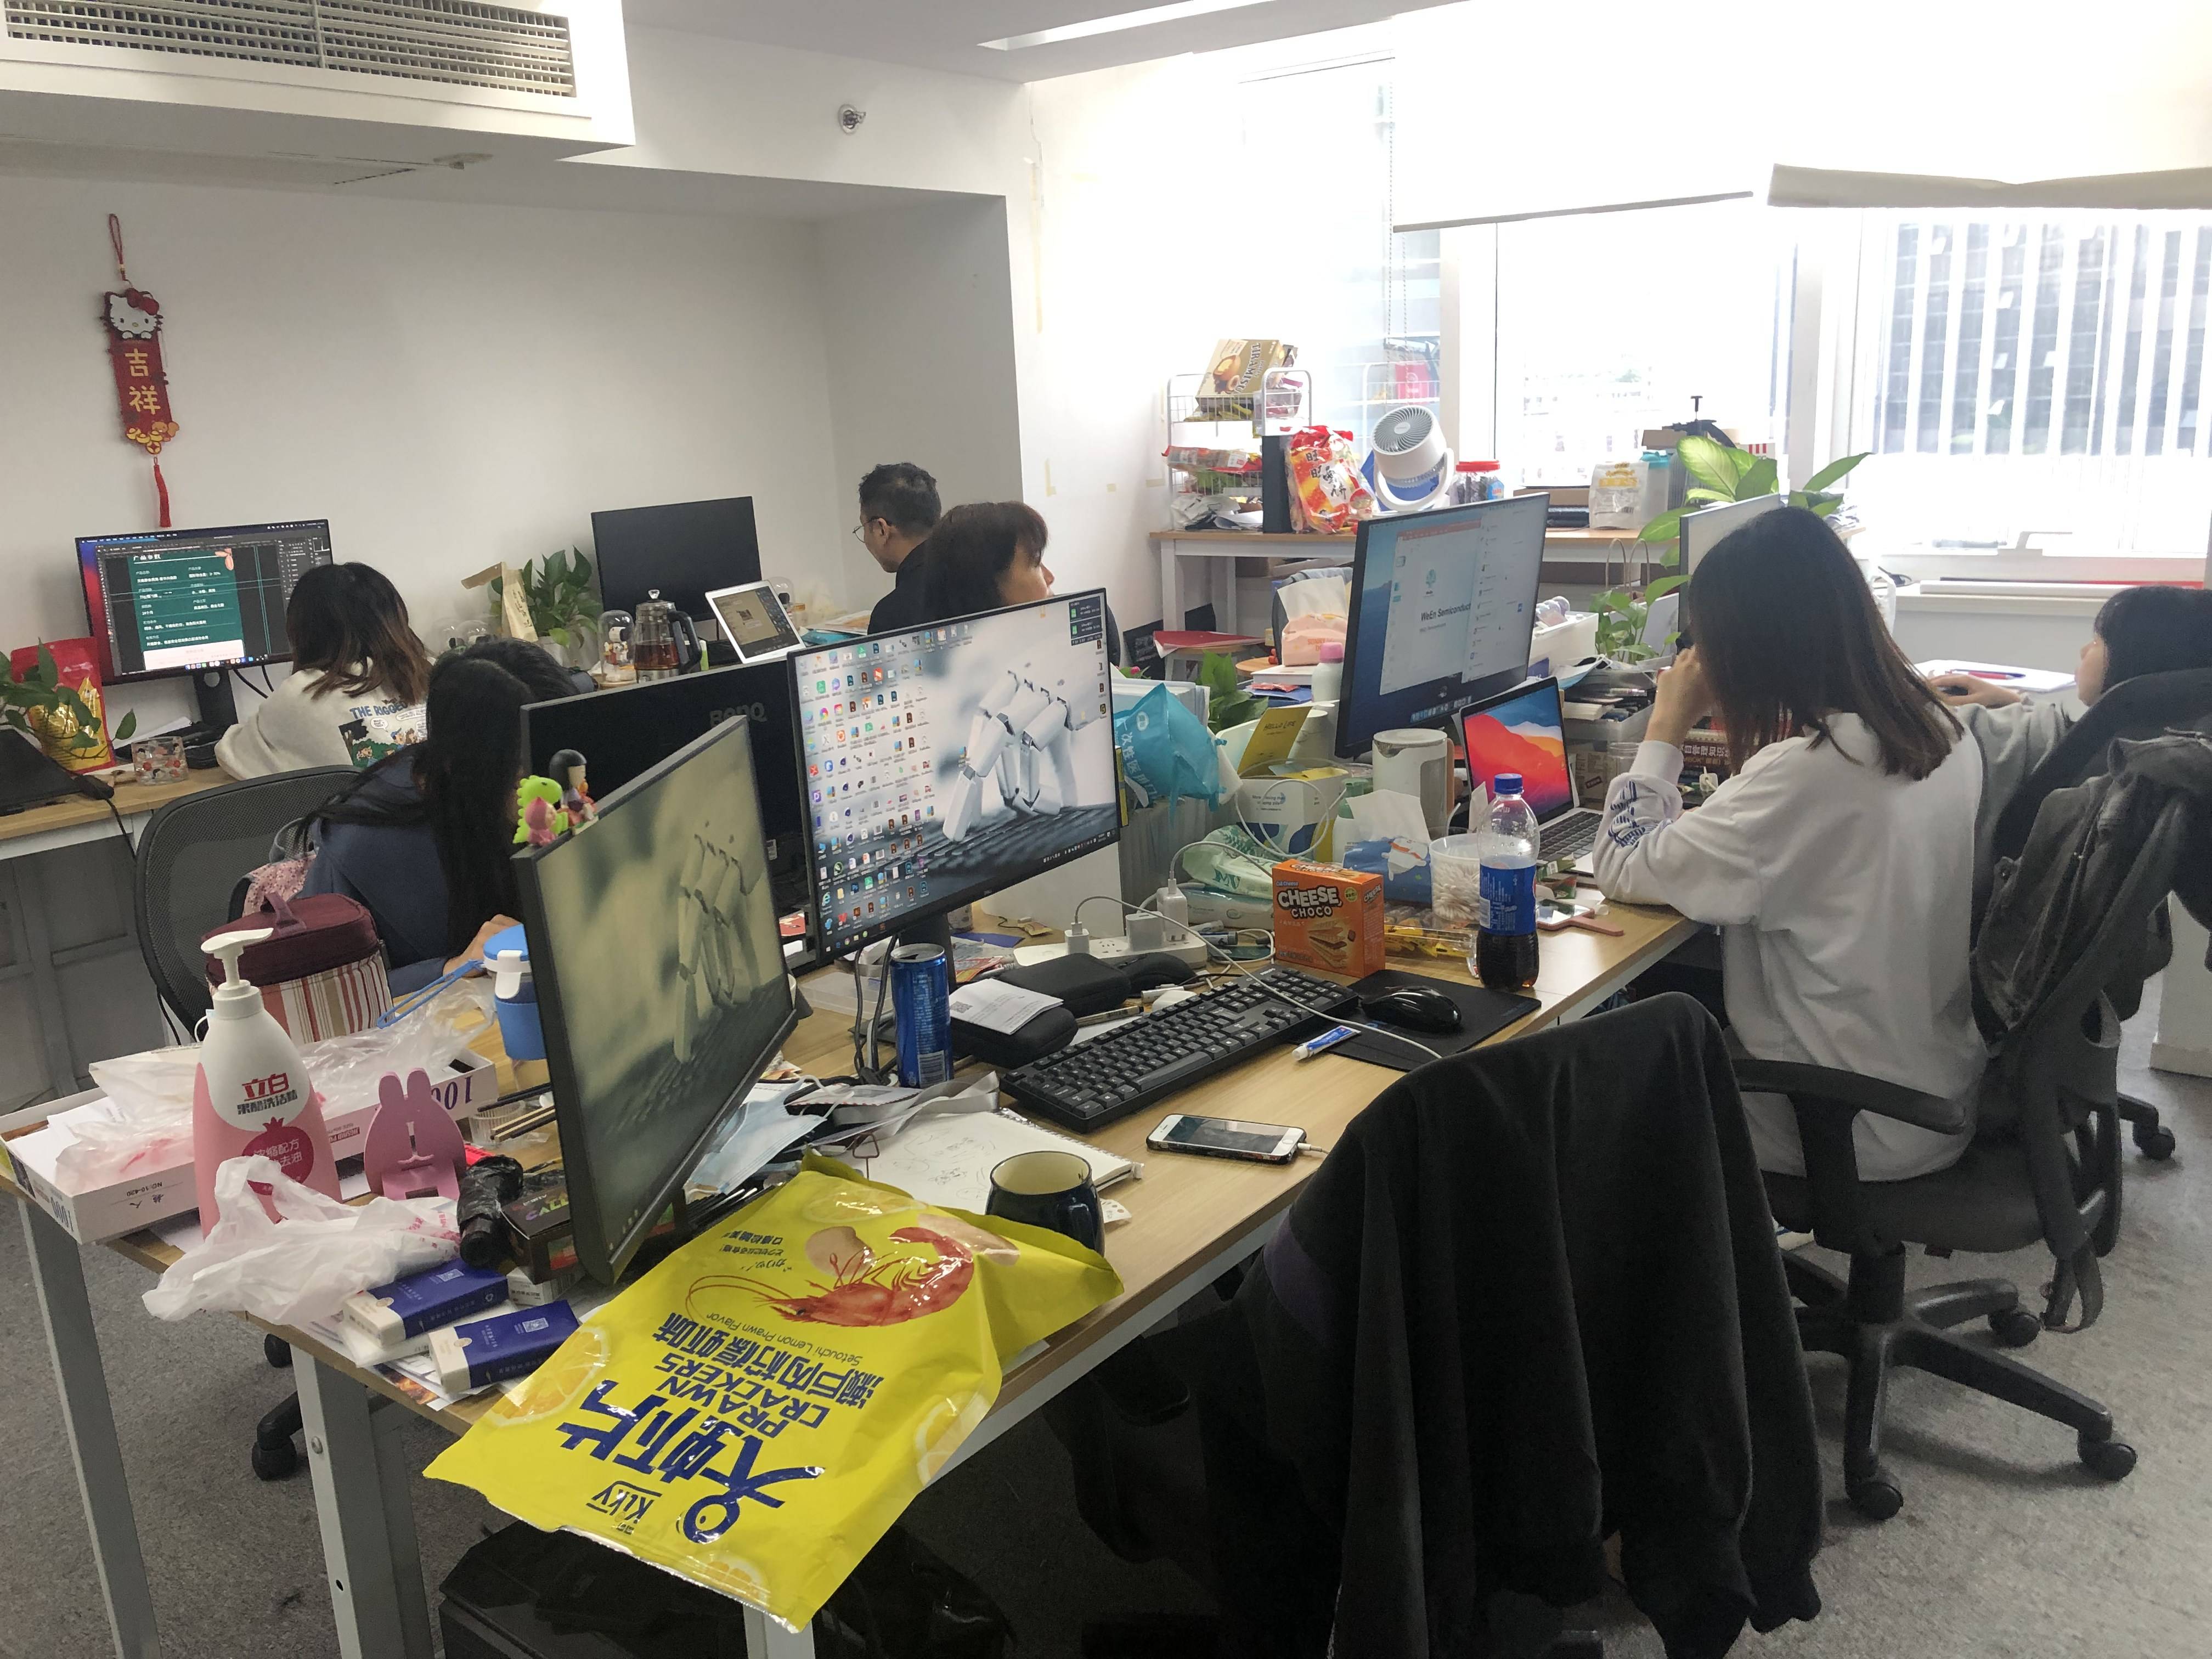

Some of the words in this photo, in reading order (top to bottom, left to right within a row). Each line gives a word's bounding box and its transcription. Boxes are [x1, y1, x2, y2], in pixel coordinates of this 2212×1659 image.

[1234, 342, 1261, 393] TIRAMISU
[125, 348, 161, 414] 吉祥
[349, 706, 373, 720] THE
[1278, 887, 1340, 907] CHEESE
[1291, 905, 1332, 918] CHOCO
[241, 1073, 290, 1102] 立白
[706, 1312, 743, 1331] Flavor
[742, 1324, 777, 1342] Prawn
[777, 1335, 813, 1353] Lemon
[815, 1346, 864, 1366] Setouchi
[654, 1352, 830, 1429] CRACKERS
[655, 1375, 785, 1438] PRAWN
